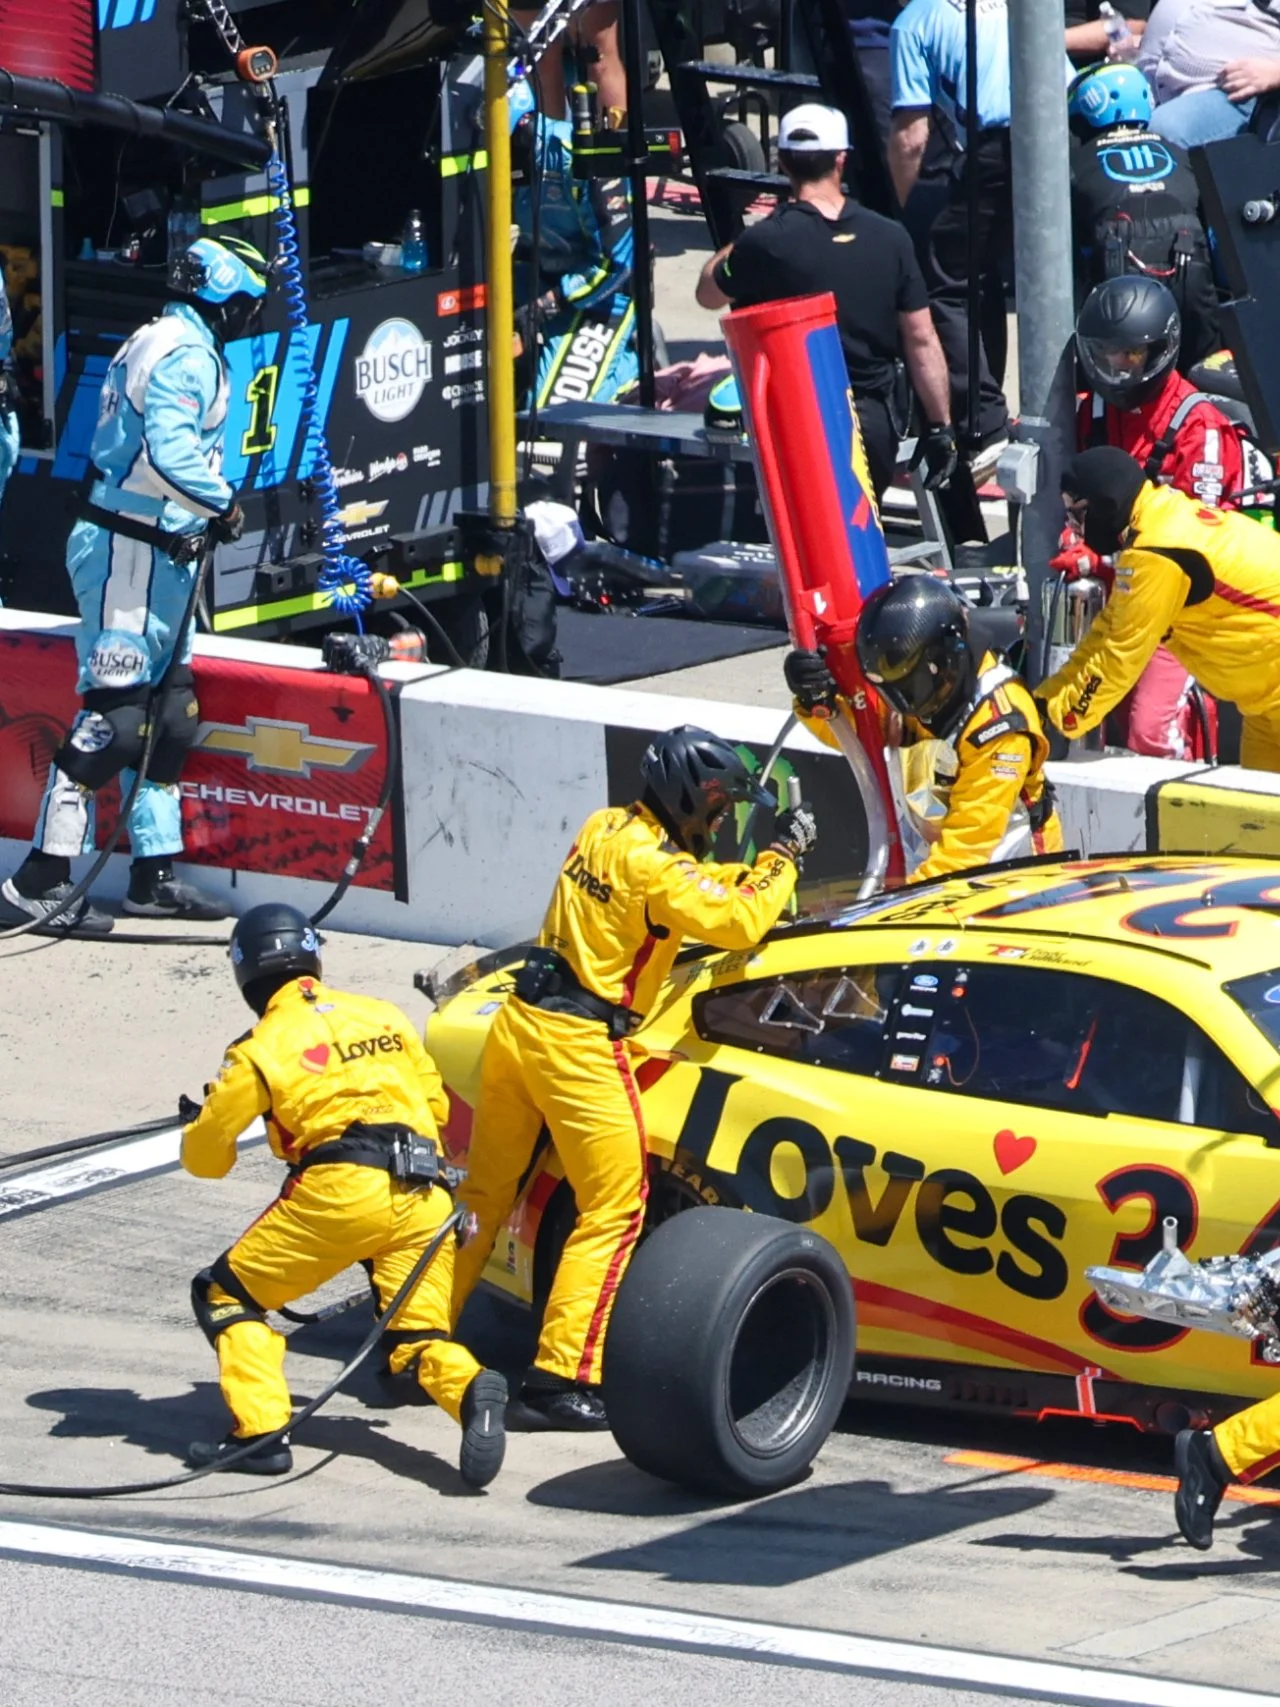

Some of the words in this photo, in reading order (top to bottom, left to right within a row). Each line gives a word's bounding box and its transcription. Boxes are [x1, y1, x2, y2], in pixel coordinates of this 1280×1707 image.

[357, 343, 431, 391] BUSCH
[550, 322, 613, 404] OUSE
[373, 383, 416, 404] LIGHT
[241, 365, 278, 456] 1
[323, 524, 390, 547] EVROLET
[90, 649, 144, 672] BUSCH
[180, 782, 382, 821] CHEVROLET
[855, 1370, 943, 1392] RACING
